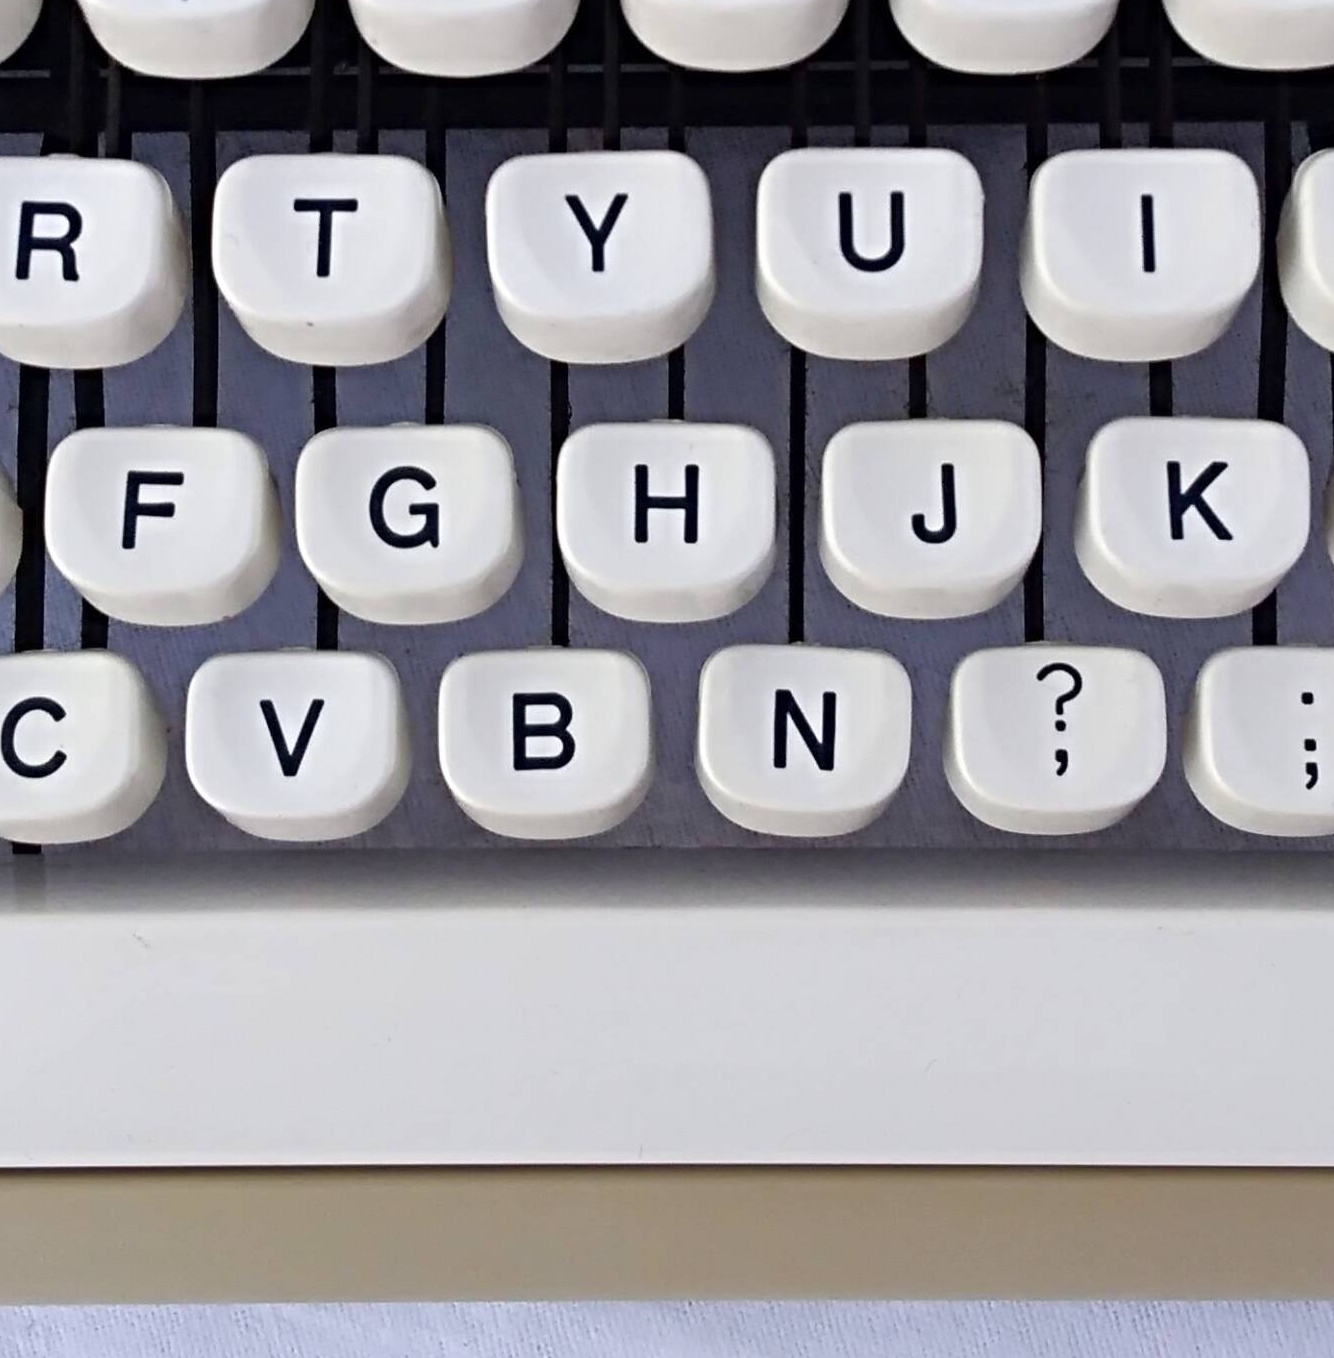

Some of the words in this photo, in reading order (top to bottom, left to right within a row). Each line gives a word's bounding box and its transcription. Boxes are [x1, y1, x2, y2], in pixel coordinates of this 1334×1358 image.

[16, 201, 82, 282] R
[294, 199, 358, 277] T
[565, 194, 628, 272] Y
[839, 191, 905, 272] U
[1141, 195, 1155, 273] I
[122, 471, 184, 549] F
[369, 466, 439, 549] G
[635, 464, 699, 544] H
[912, 463, 956, 544] J
[1167, 461, 1233, 540] K
[513, 693, 575, 771] B
[774, 689, 836, 771] N
[1037, 663, 1082, 731] ?
[1, 697, 67, 778] C
[260, 699, 324, 777] V
[1304, 739, 1318, 790] ;
